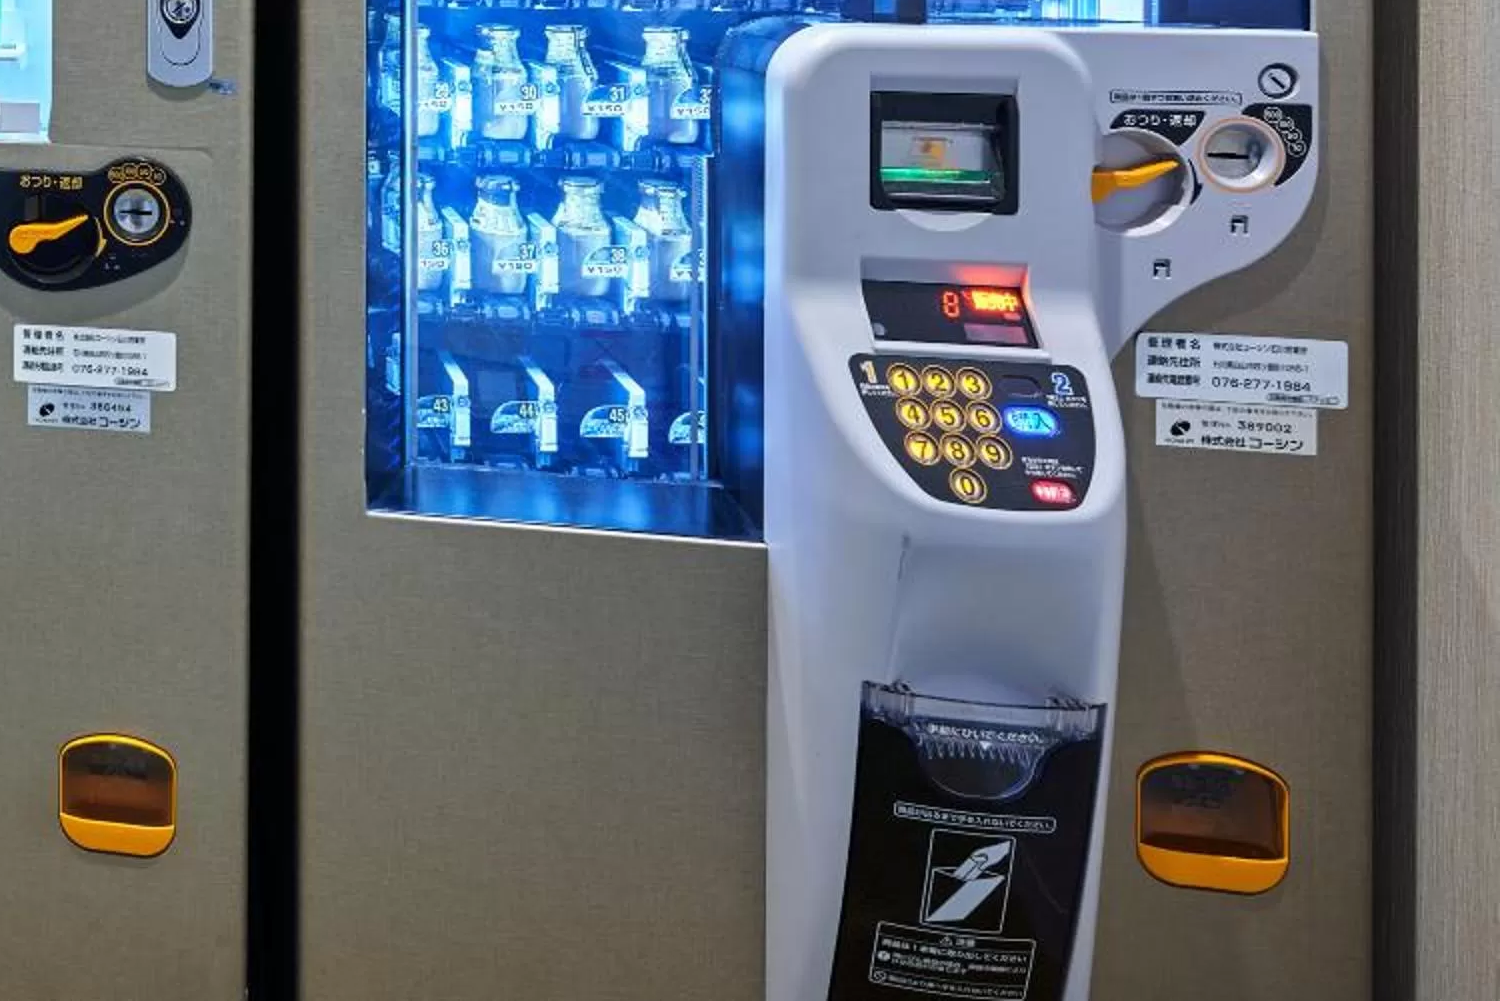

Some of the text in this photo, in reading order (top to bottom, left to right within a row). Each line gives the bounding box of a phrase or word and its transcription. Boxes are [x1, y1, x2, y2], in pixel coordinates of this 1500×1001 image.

[609, 86, 626, 101] 31
[20, 174, 84, 191] おつり・返却
[1147, 337, 1201, 350] 管理者名
[860, 361, 877, 383] 1
[897, 372, 909, 390] 1
[931, 373, 946, 392] 2
[965, 374, 982, 394] 3
[1051, 372, 1074, 396] 2
[432, 399, 449, 413] 43
[519, 403, 536, 418] 44
[907, 405, 921, 423] 4
[609, 408, 626, 423] 45
[941, 406, 956, 426] 5
[975, 408, 991, 427] 6
[914, 440, 928, 459] 7
[951, 441, 966, 461] 8
[1201, 435, 1304, 451] 株式会社コーシン
[985, 443, 1001, 463] 9
[960, 477, 975, 495] 0
